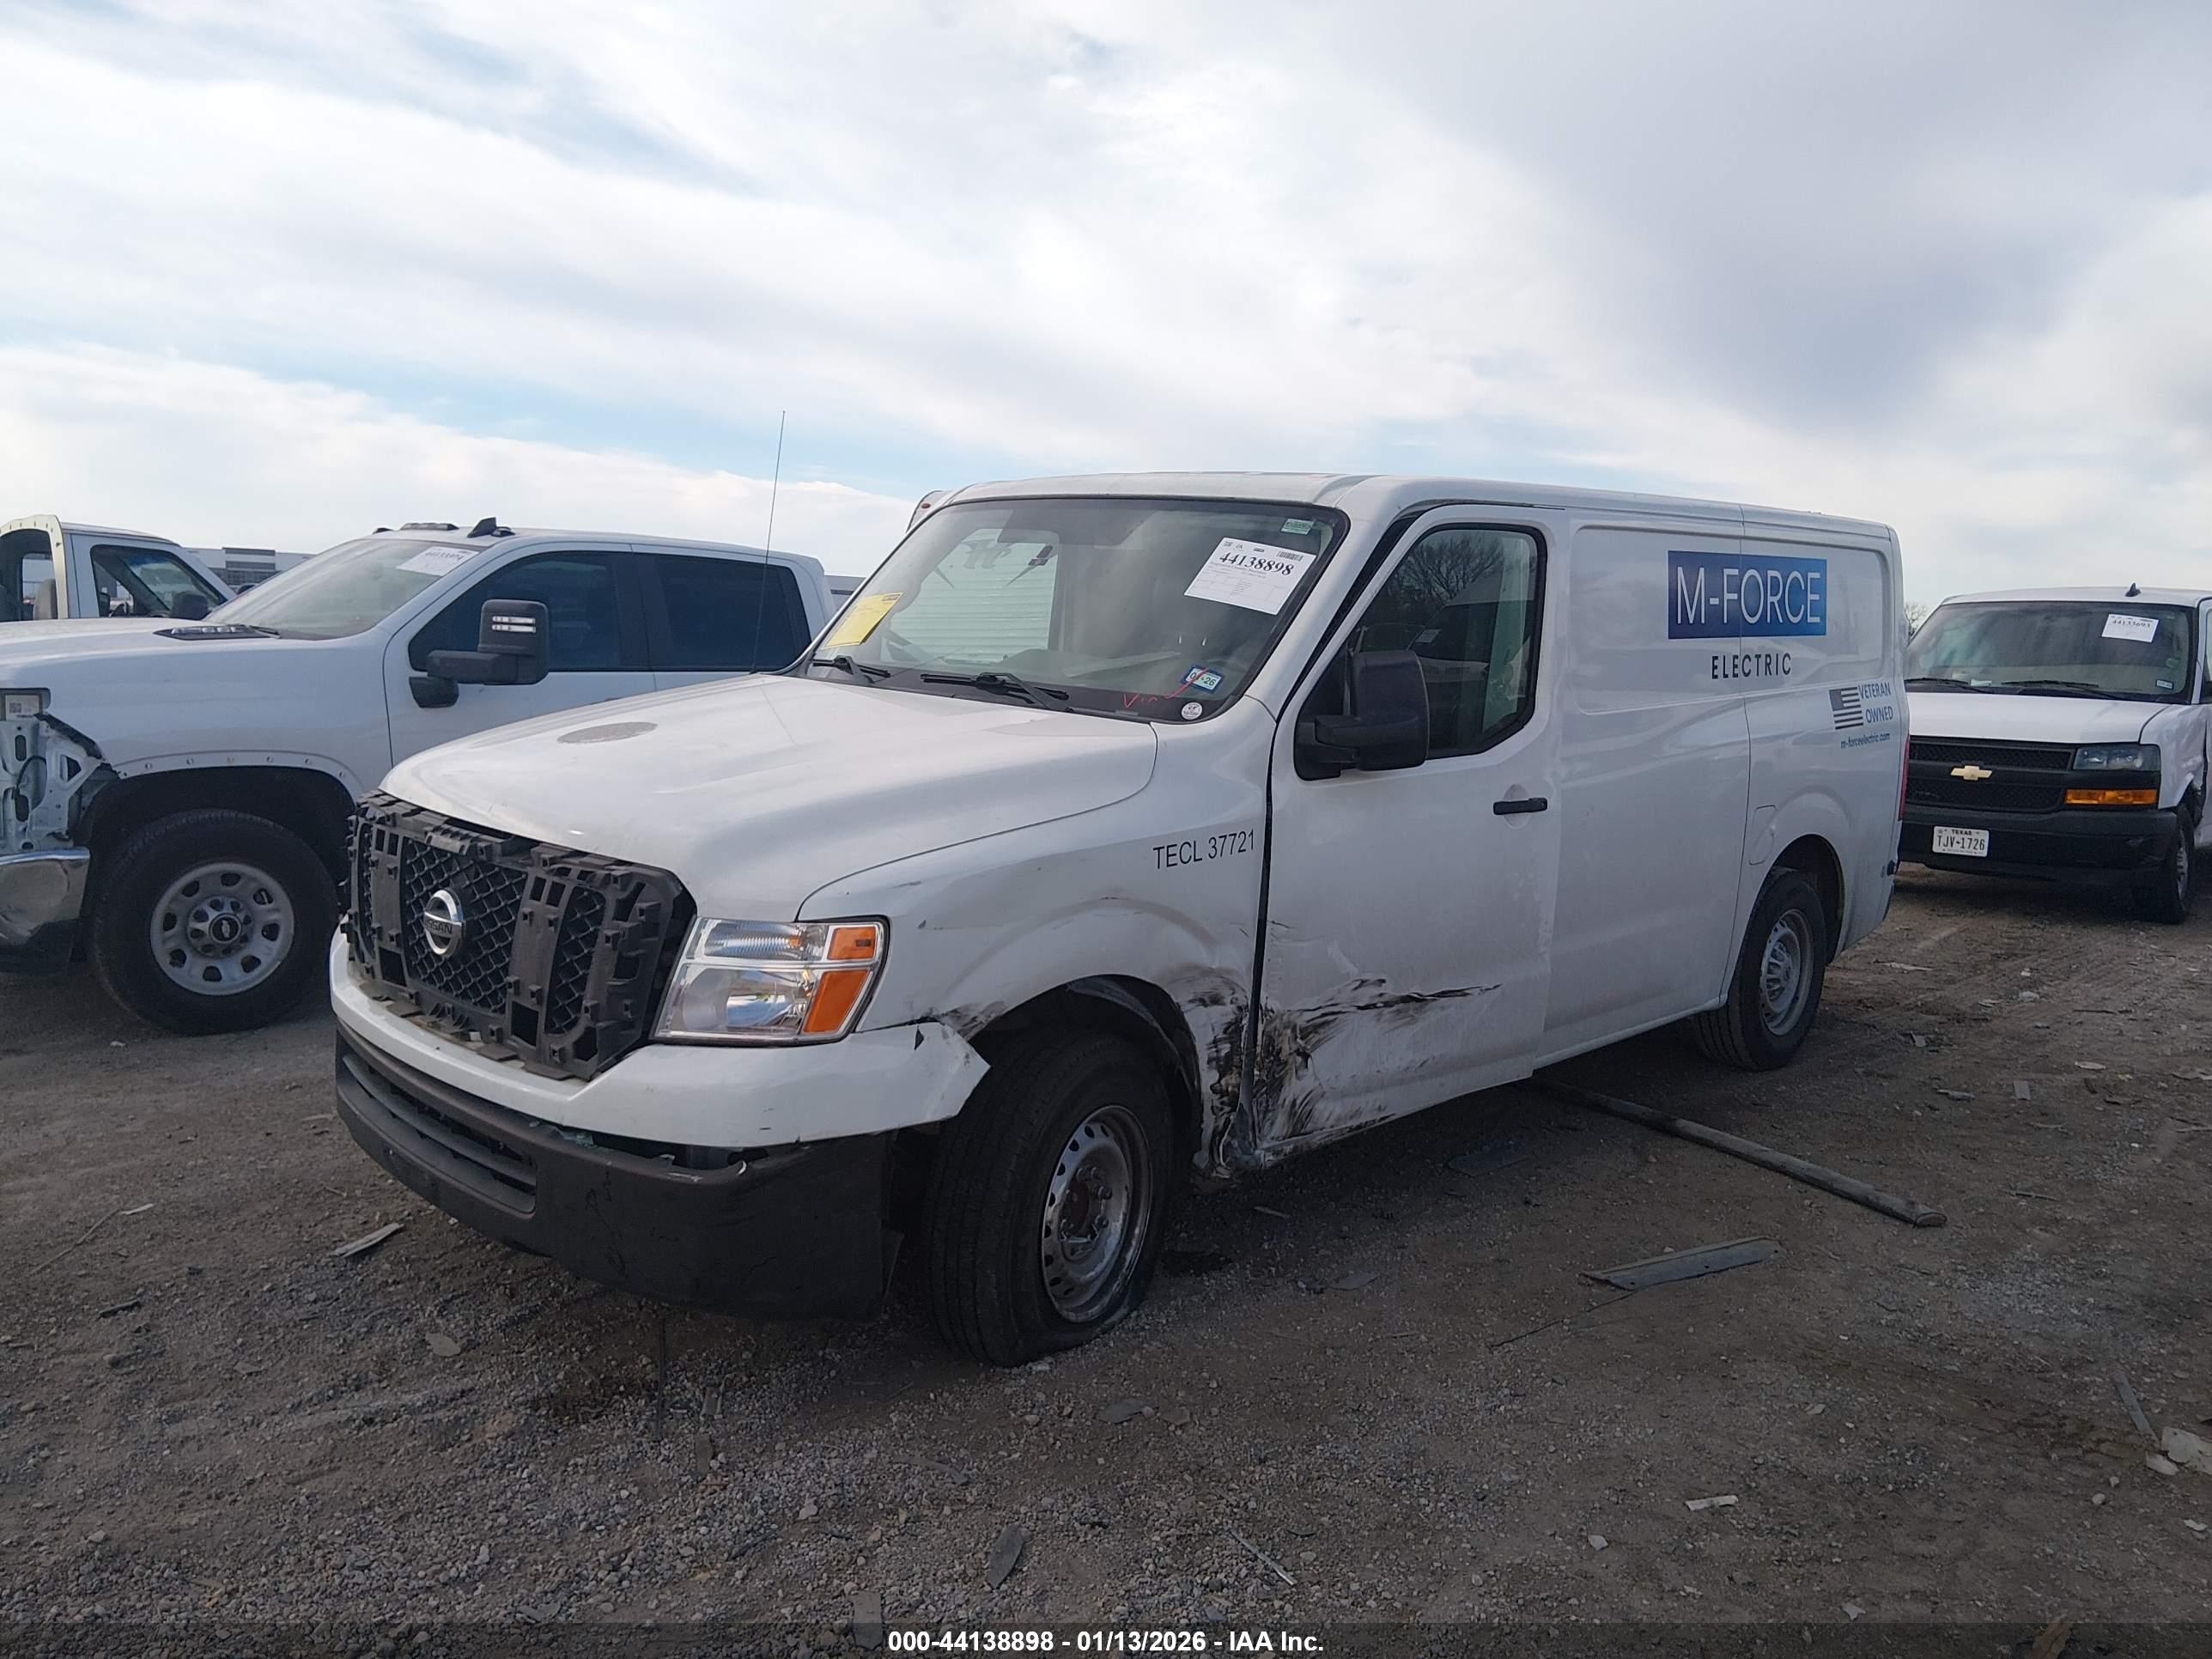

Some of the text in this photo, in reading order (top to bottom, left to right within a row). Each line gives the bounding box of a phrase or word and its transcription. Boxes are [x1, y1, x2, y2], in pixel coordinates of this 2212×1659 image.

[1219, 552, 1294, 575] 44138898
[1677, 566, 1820, 624] M-FORCE
[1711, 653, 1791, 679] ELECTRIC
[1189, 672, 1217, 687] 0-26
[1858, 682, 1891, 700] VETERAN
[1865, 706, 1893, 723] OWNED
[1152, 829, 1255, 869] TECL 37721
